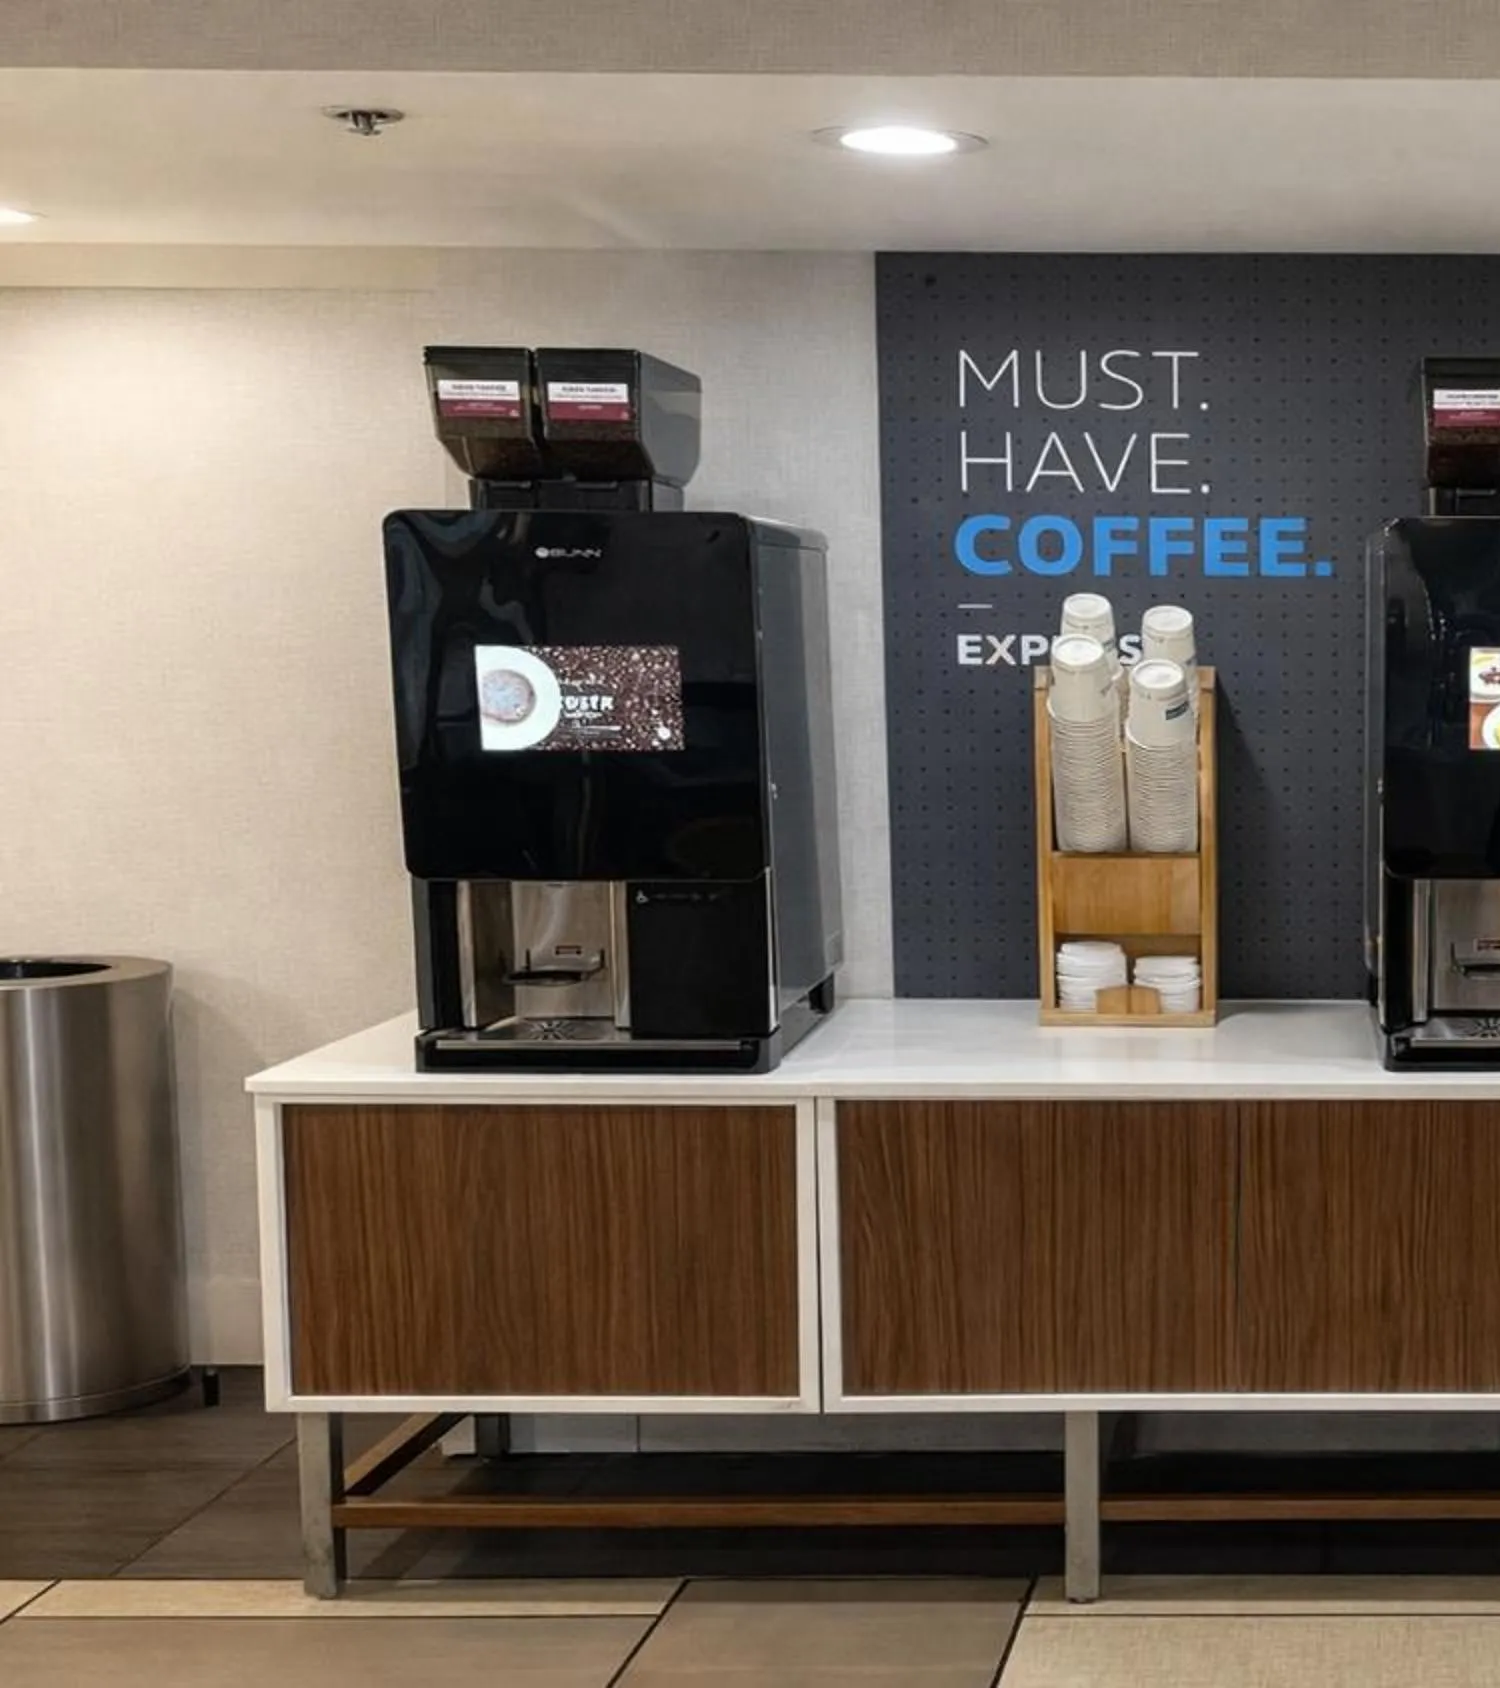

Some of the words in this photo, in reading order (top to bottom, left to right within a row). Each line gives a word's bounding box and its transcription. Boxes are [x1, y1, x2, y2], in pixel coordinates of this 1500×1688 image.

[957, 349, 1211, 411] MUST.
[958, 431, 1211, 495] HAVE.
[954, 513, 1334, 578] COFFEE.
